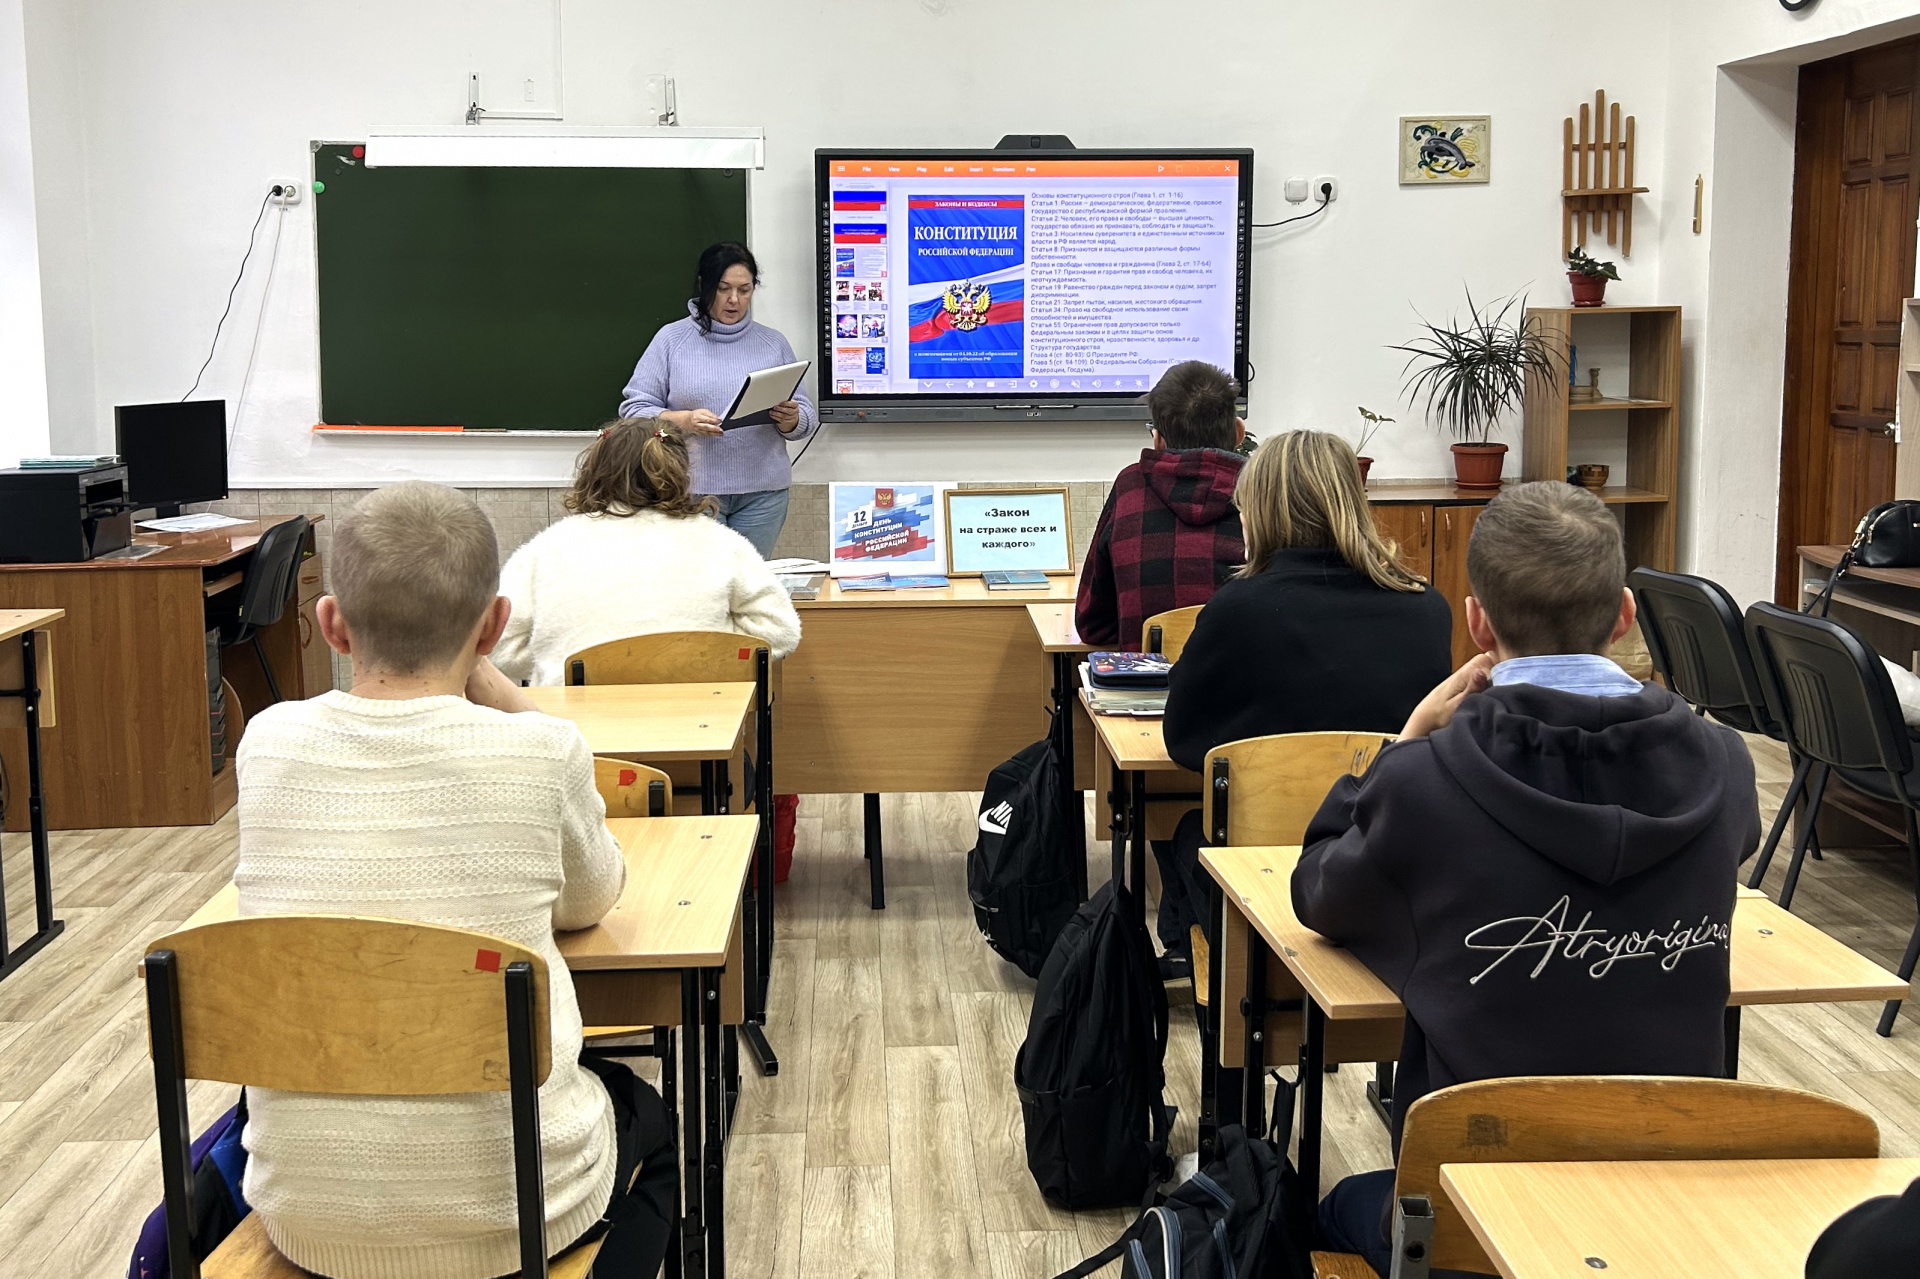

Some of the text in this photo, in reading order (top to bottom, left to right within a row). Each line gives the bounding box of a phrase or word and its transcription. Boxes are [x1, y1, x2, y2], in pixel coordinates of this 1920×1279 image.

[914, 226, 1018, 242] КОНСТИТУЦИЯ
[918, 247, 1014, 256] РОССИЙСКОЙ ФЕДЕРАЦИИ
[854, 510, 866, 523] 12
[985, 508, 1030, 517] «Закон
[872, 518, 892, 528] ДЕНЬ
[854, 522, 902, 538] КОНСТИТУЦИИ
[976, 526, 1017, 535] страже
[865, 530, 910, 546] РОССИЙСКОЙ
[865, 538, 908, 552] ФЕДЕРАЦИИ
[982, 541, 1036, 549] каждого»
